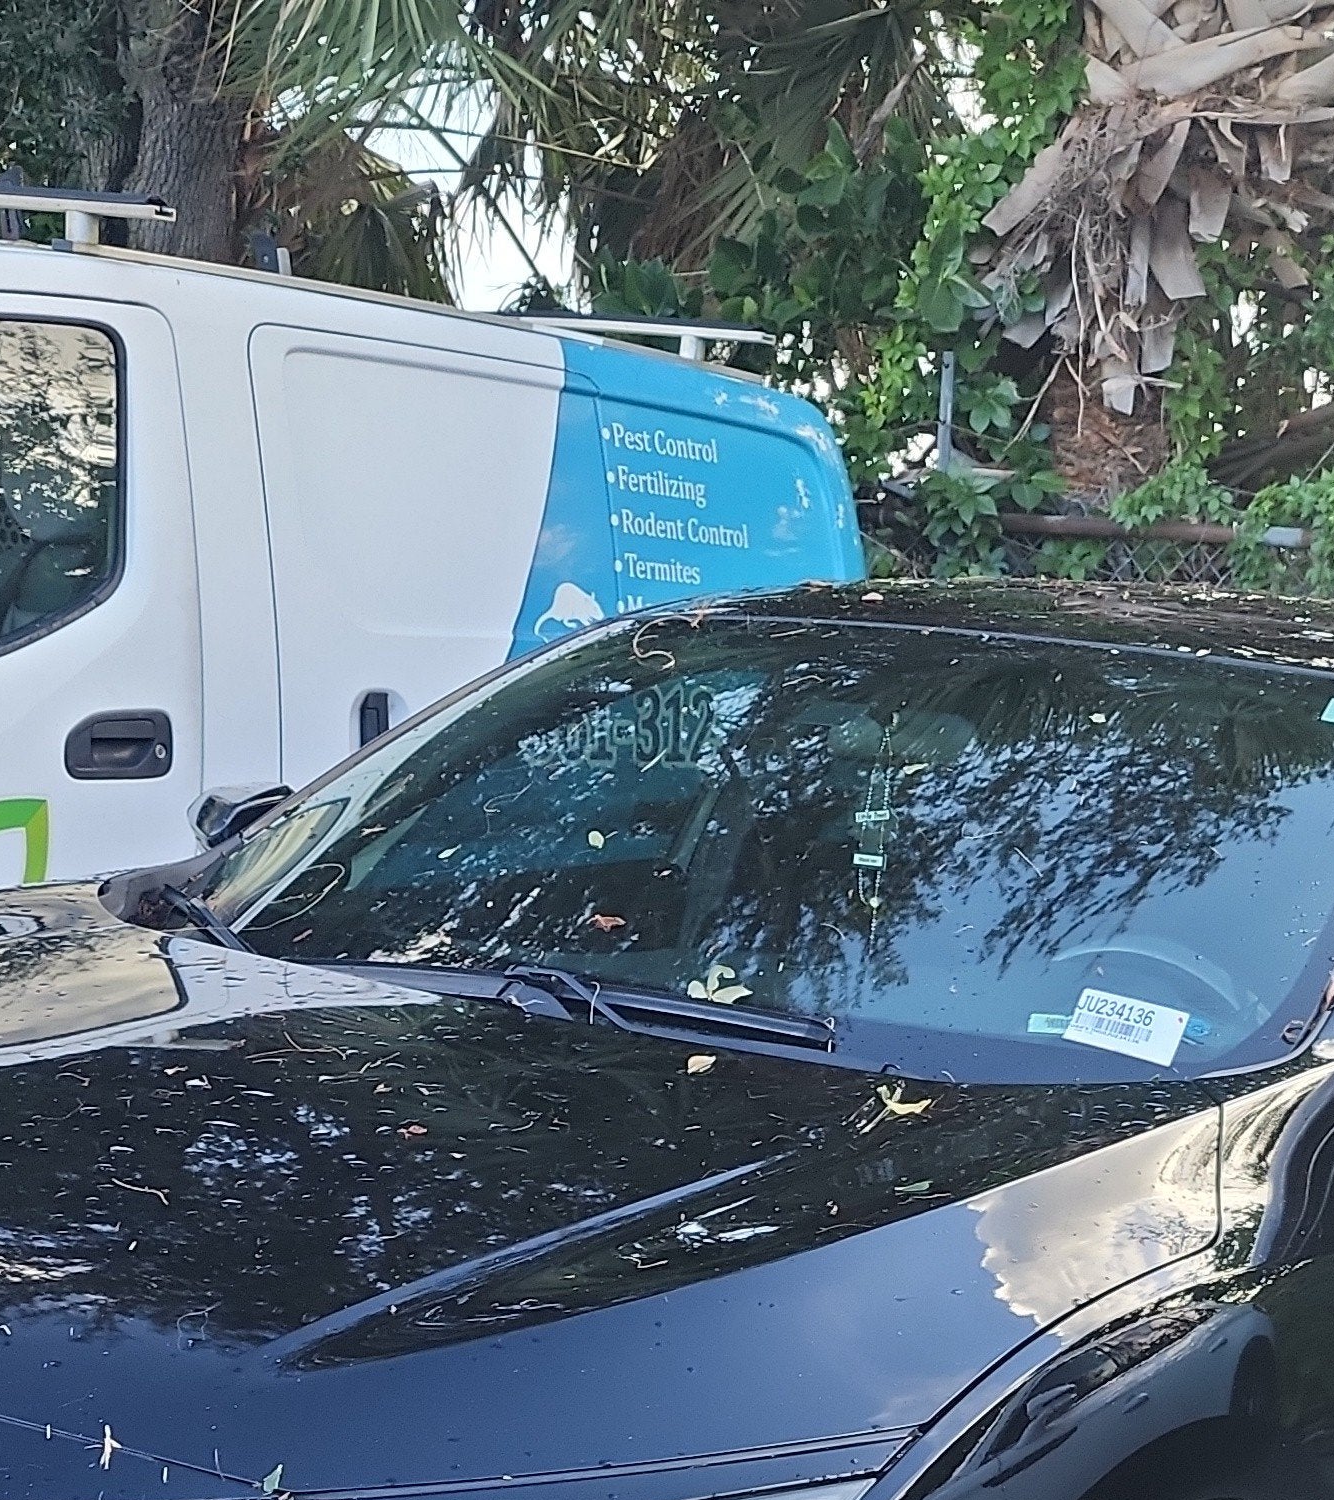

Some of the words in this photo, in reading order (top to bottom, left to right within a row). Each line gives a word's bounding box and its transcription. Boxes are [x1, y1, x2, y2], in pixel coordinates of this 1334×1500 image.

[612, 423, 652, 453] Pest
[654, 430, 718, 464] Control
[617, 465, 707, 509] Fertilizing
[621, 508, 685, 541] Rodent
[687, 517, 750, 549] Control
[624, 552, 701, 585] Termites
[1077, 994, 1156, 1027] JU234136
